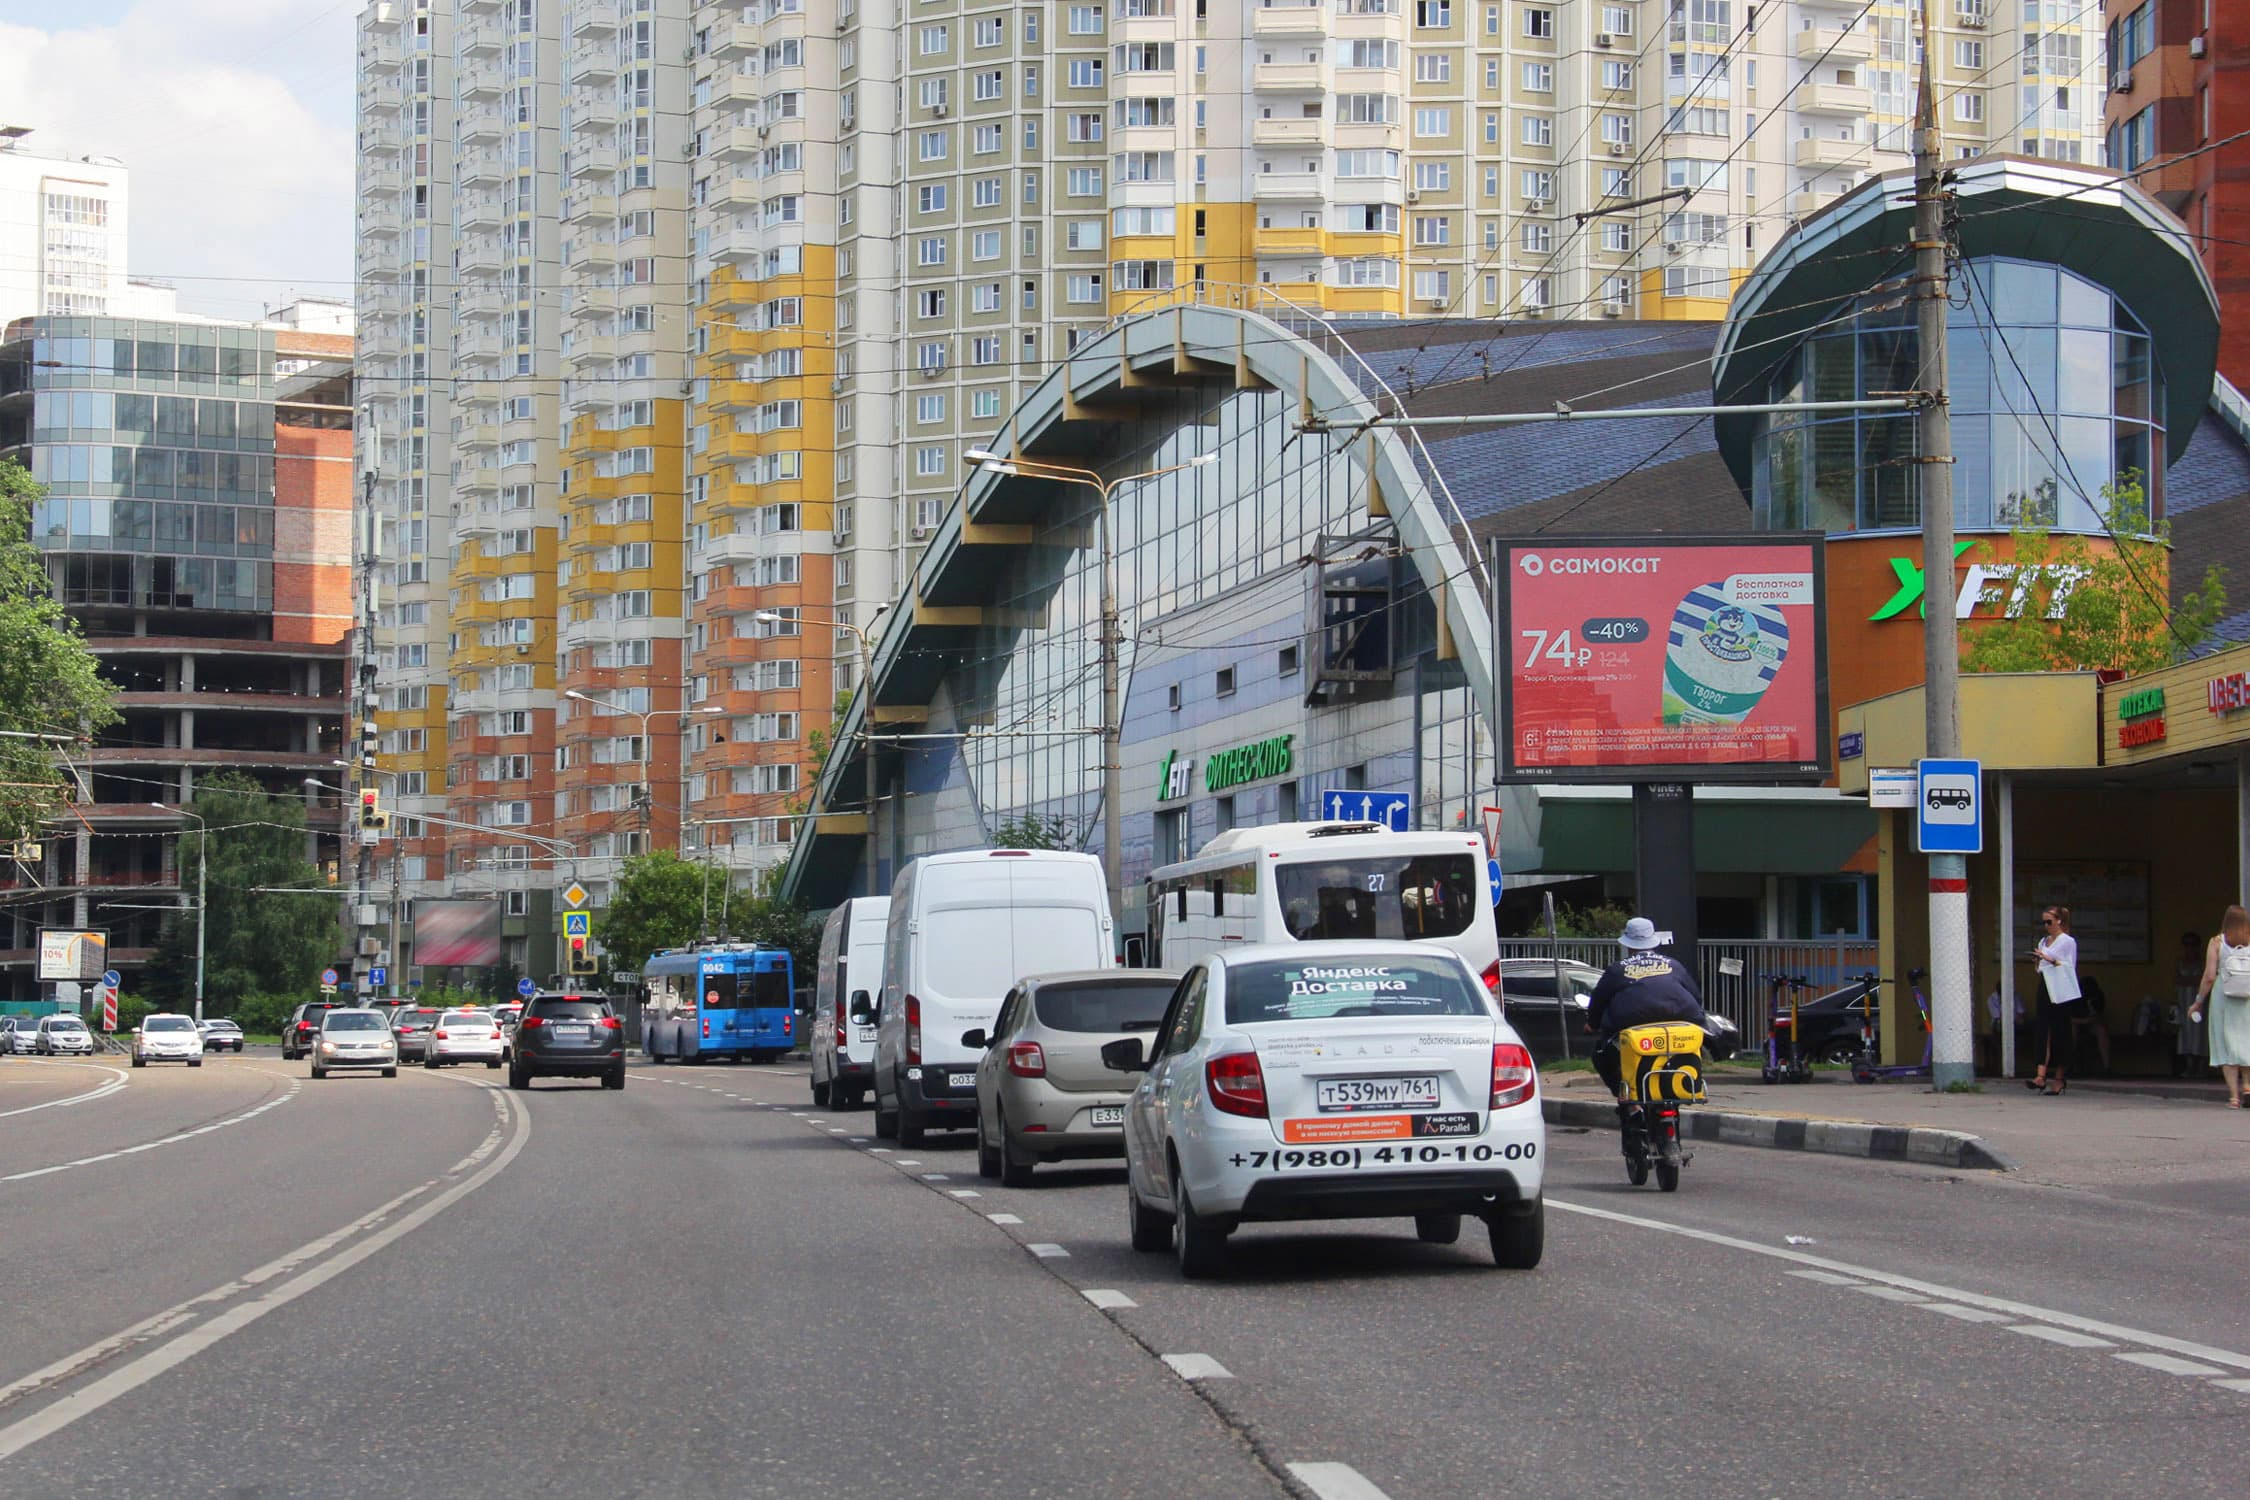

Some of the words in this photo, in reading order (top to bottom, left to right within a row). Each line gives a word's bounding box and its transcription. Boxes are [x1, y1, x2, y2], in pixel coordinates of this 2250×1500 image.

[1549, 557, 1661, 574] самокат
[1735, 579, 1804, 589] Бесплатная
[1735, 590, 1790, 601] доставка
[1700, 636, 1751, 661] ПРОСТОКВАШИНО
[1599, 651, 1630, 667] 124
[1693, 685, 1728, 704] ТВОРОГ
[1697, 700, 1711, 710] 2%
[1525, 733, 1539, 746] 6+
[1205, 734, 1293, 792] ФИТНЕС-КЛУБ
[1367, 873, 1384, 892] 27
[43, 950, 63, 959] 10%
[703, 963, 724, 973] 0042
[1301, 966, 1390, 980] Яндекс
[1291, 979, 1407, 996] Доставка
[1333, 1045, 1421, 1056] LADA
[1325, 1082, 1398, 1102] Т539МУ
[1404, 1080, 1432, 1094] 761
[1440, 1122, 1470, 1134] Parallel
[1229, 1148, 1361, 1171] +7(980)
[1374, 1142, 1536, 1163] 410-10-00
